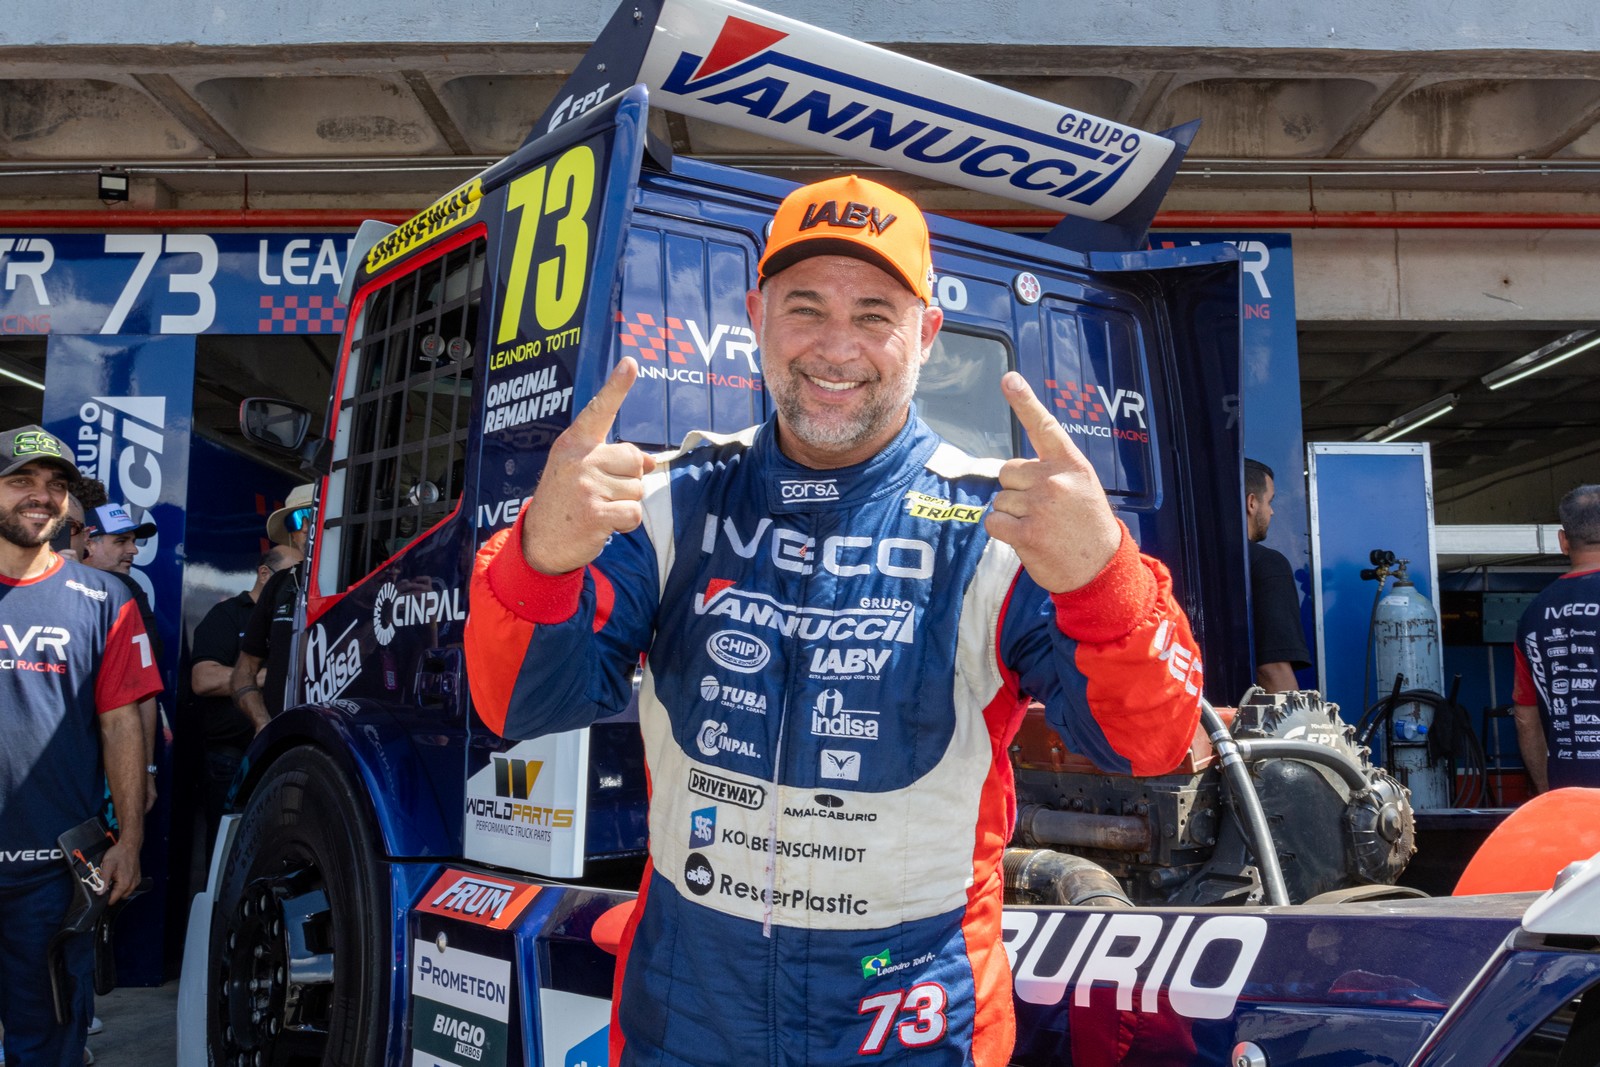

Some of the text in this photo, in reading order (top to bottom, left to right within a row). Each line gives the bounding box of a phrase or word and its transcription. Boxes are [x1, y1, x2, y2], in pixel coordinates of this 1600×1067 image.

[567, 82, 610, 120] FPT
[660, 50, 1126, 206] VANNUCCI
[1056, 113, 1141, 154] GRUPO
[259, 239, 357, 286] LEA
[497, 145, 595, 346] 73
[100, 234, 219, 334] 73
[0, 314, 51, 333] CING
[490, 326, 581, 371] LEANDRO TOTTI
[486, 365, 558, 408] ORIGINAL
[706, 373, 762, 391] RACING
[484, 387, 574, 435] REMAN FPT
[1097, 385, 1147, 429] VR
[78, 402, 100, 480] RUPO
[1112, 428, 1149, 443] RACING
[917, 504, 981, 521] TRUCK
[702, 514, 936, 580] IVECO
[392, 588, 466, 628] CINPAL
[694, 592, 914, 643] VANNUCCI
[860, 597, 914, 612] GRUPO
[1544, 603, 1600, 620] IVECO
[3, 624, 71, 661] VR
[17, 660, 67, 675] RACING
[722, 685, 767, 711] TUBA
[812, 709, 879, 738] Indisa
[466, 797, 575, 828] WORLDPARTS
[783, 806, 878, 822] AMALCABURIO
[475, 820, 552, 843] PERFORMANCE TRUCK PARTS
[0, 848, 64, 863] IVECO
[433, 877, 515, 920] FRUM
[417, 955, 506, 1006] PROMETEON
[876, 961, 911, 977] Leandro
[432, 1013, 486, 1047] BIAGIO
[858, 981, 948, 1056] 73
[456, 1043, 481, 1061] TURBOS
